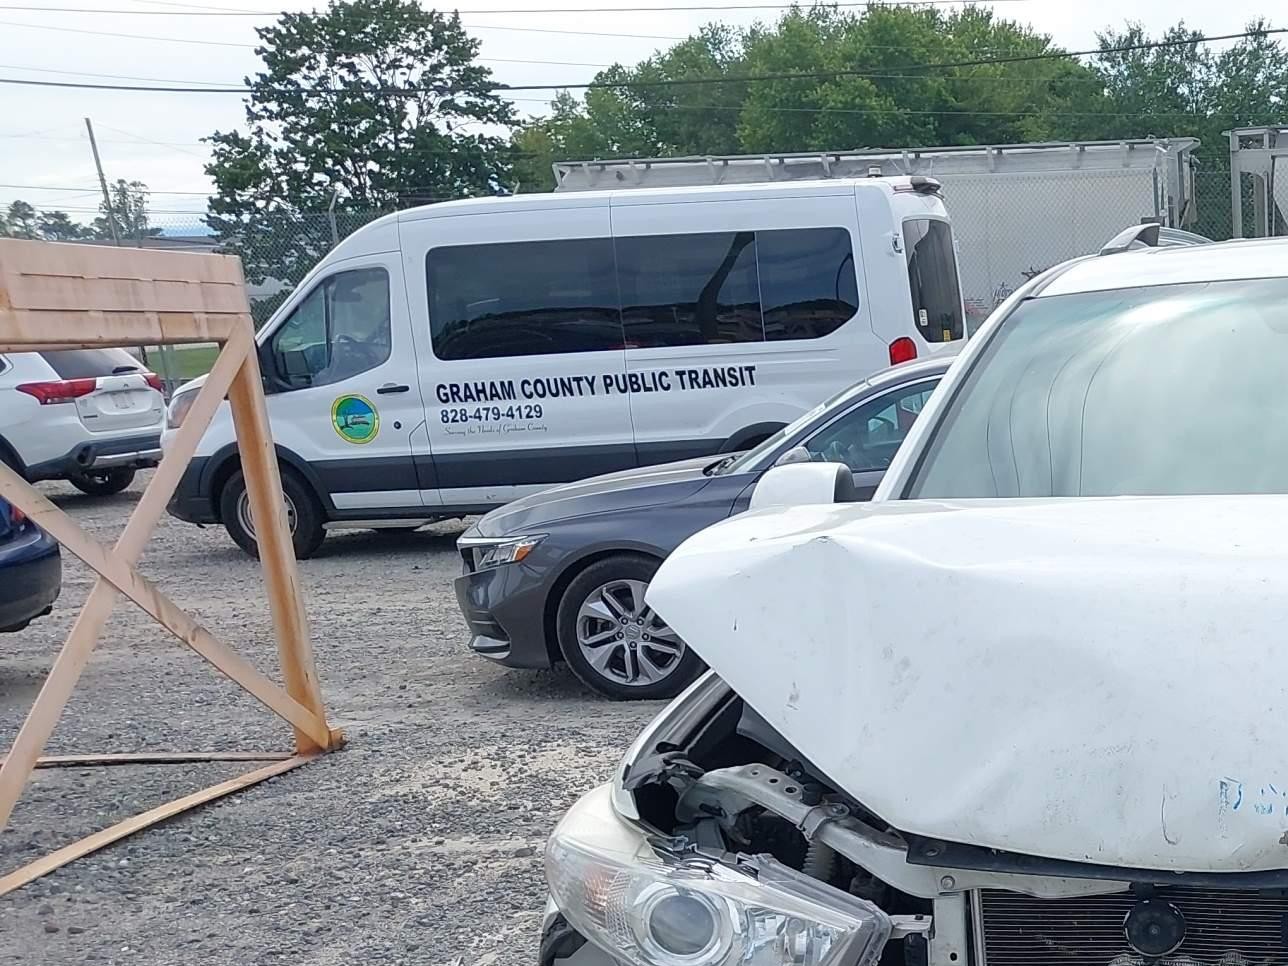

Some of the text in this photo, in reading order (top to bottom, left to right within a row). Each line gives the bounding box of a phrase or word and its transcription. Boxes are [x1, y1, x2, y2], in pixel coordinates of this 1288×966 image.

[435, 365, 757, 404] GRAHAM COUNTY PUBLIC TRANSIT
[440, 404, 543, 424] 828-479-4129
